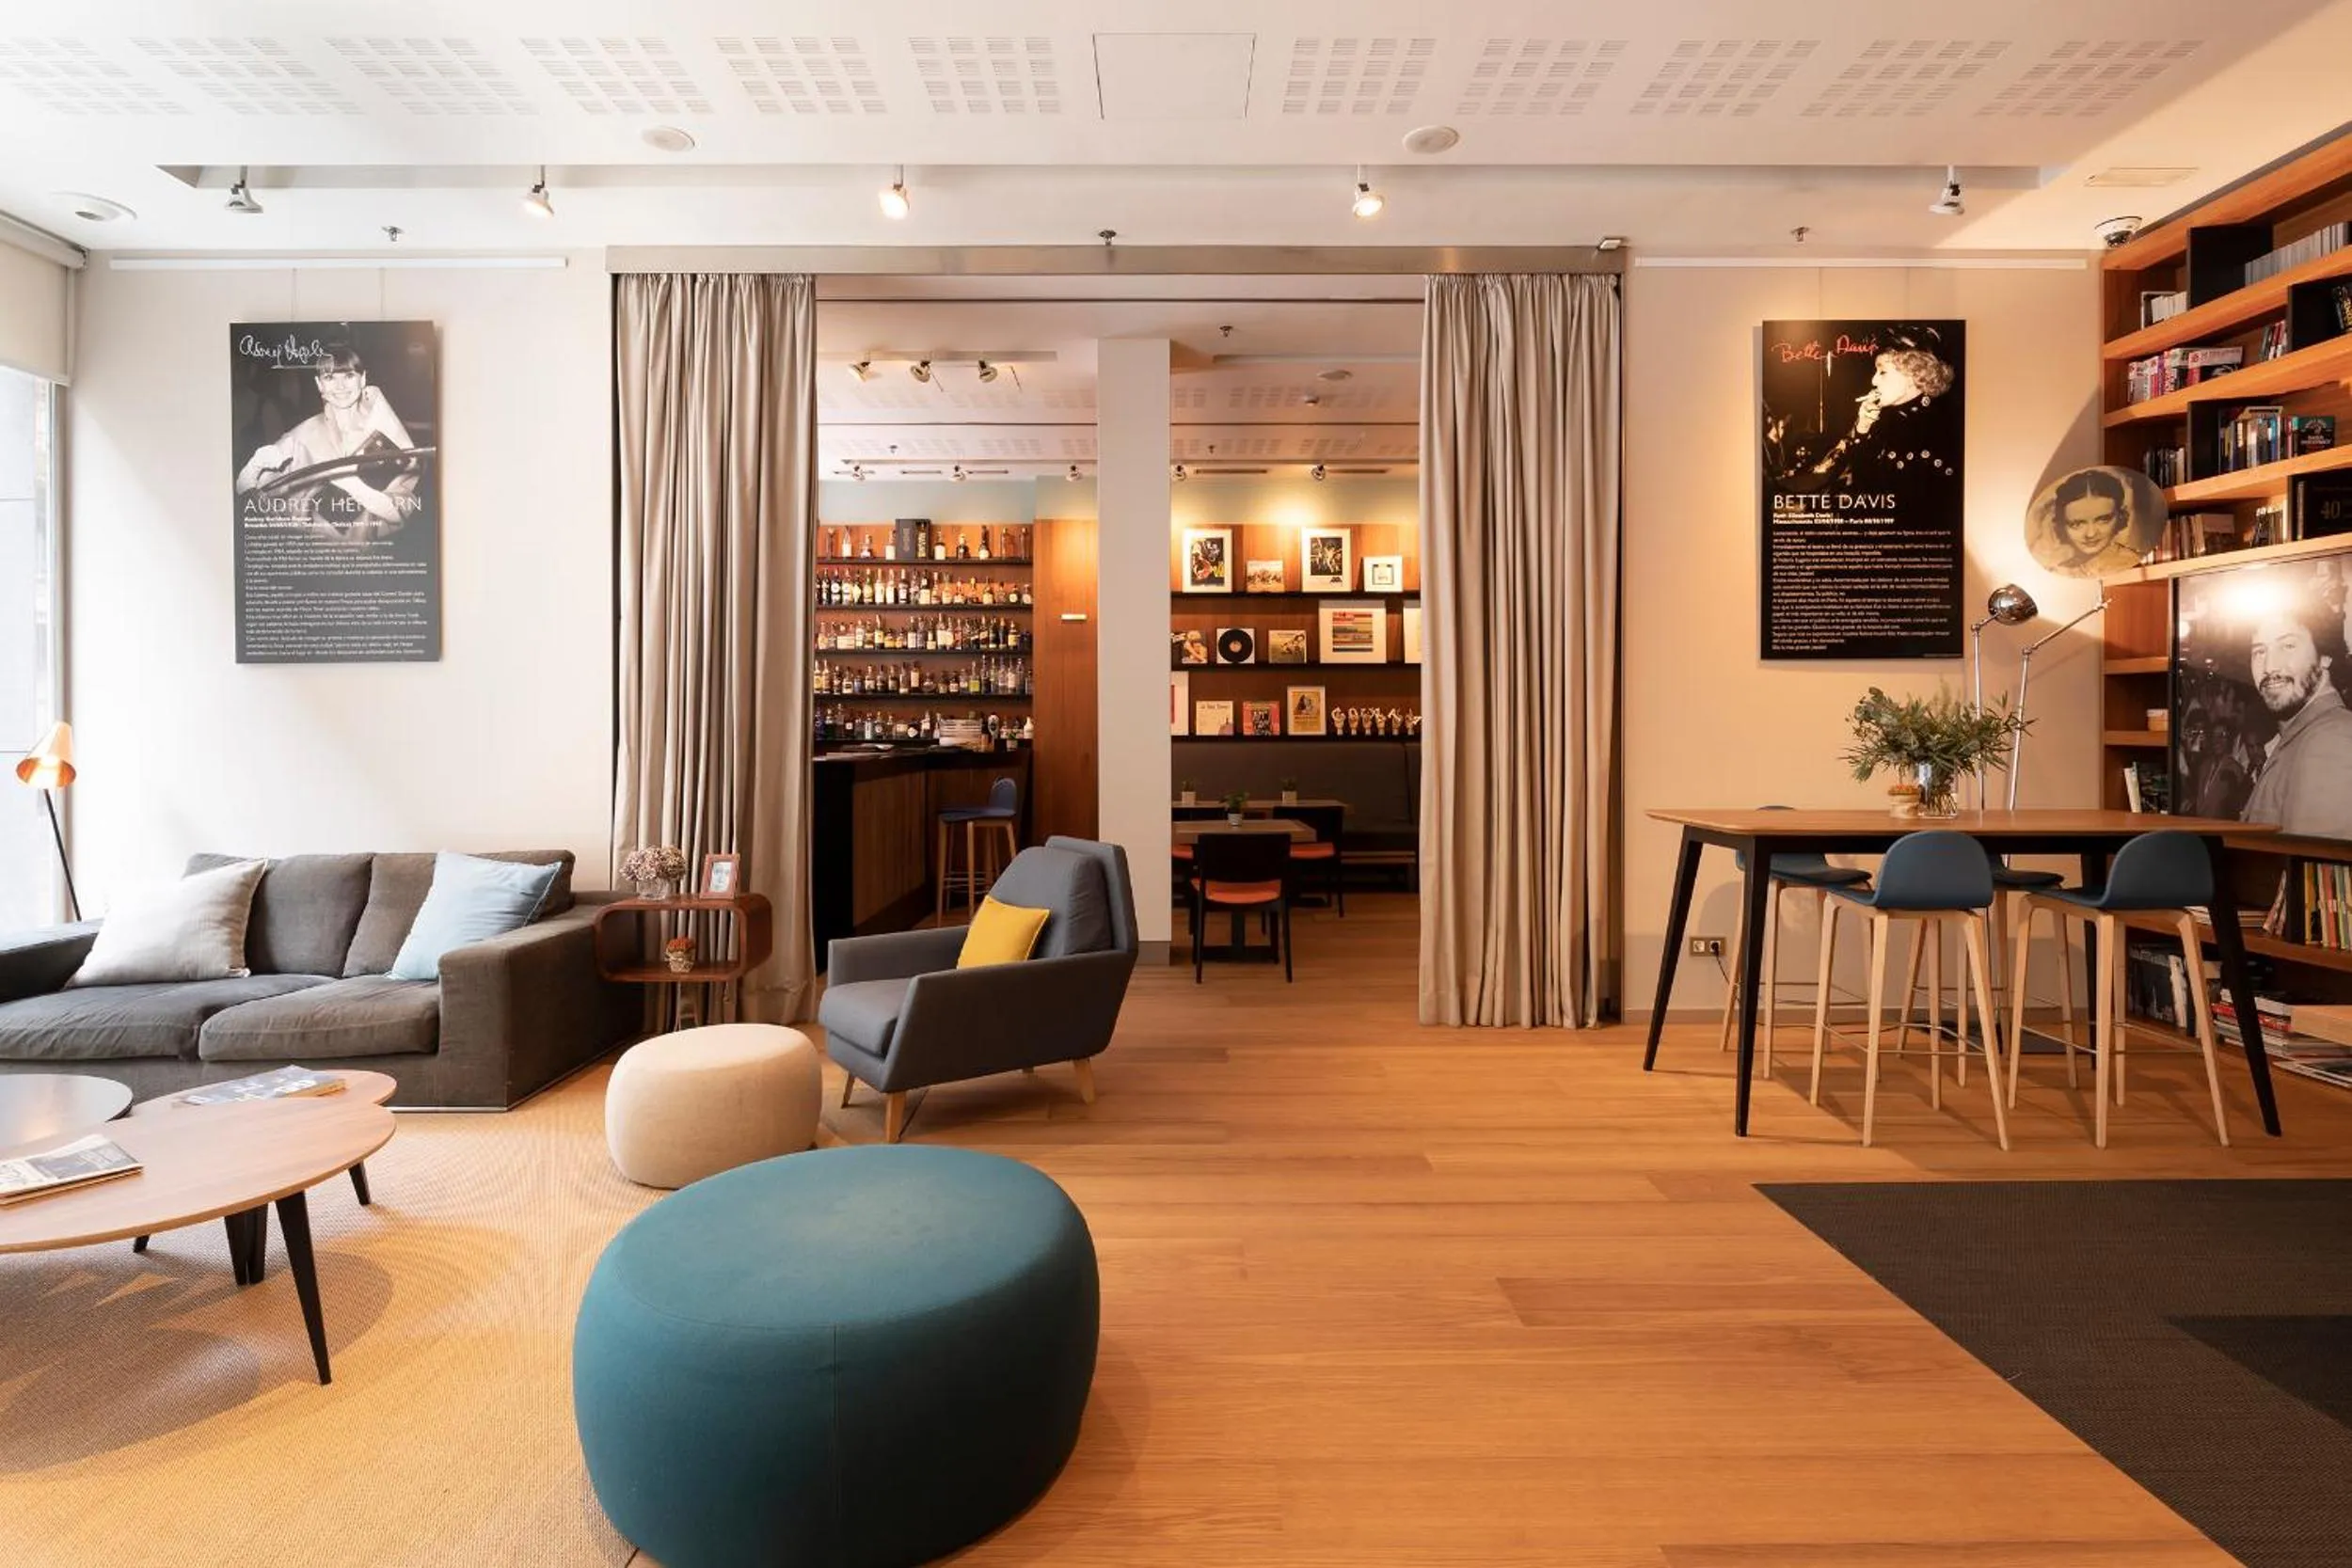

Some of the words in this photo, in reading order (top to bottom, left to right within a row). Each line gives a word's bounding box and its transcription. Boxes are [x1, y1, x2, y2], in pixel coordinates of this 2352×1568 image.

[244, 498, 323, 513] AUDREY
[331, 497, 422, 512] HERN
[1773, 495, 1831, 509] BETTE
[1838, 494, 1896, 509] DAVIS
